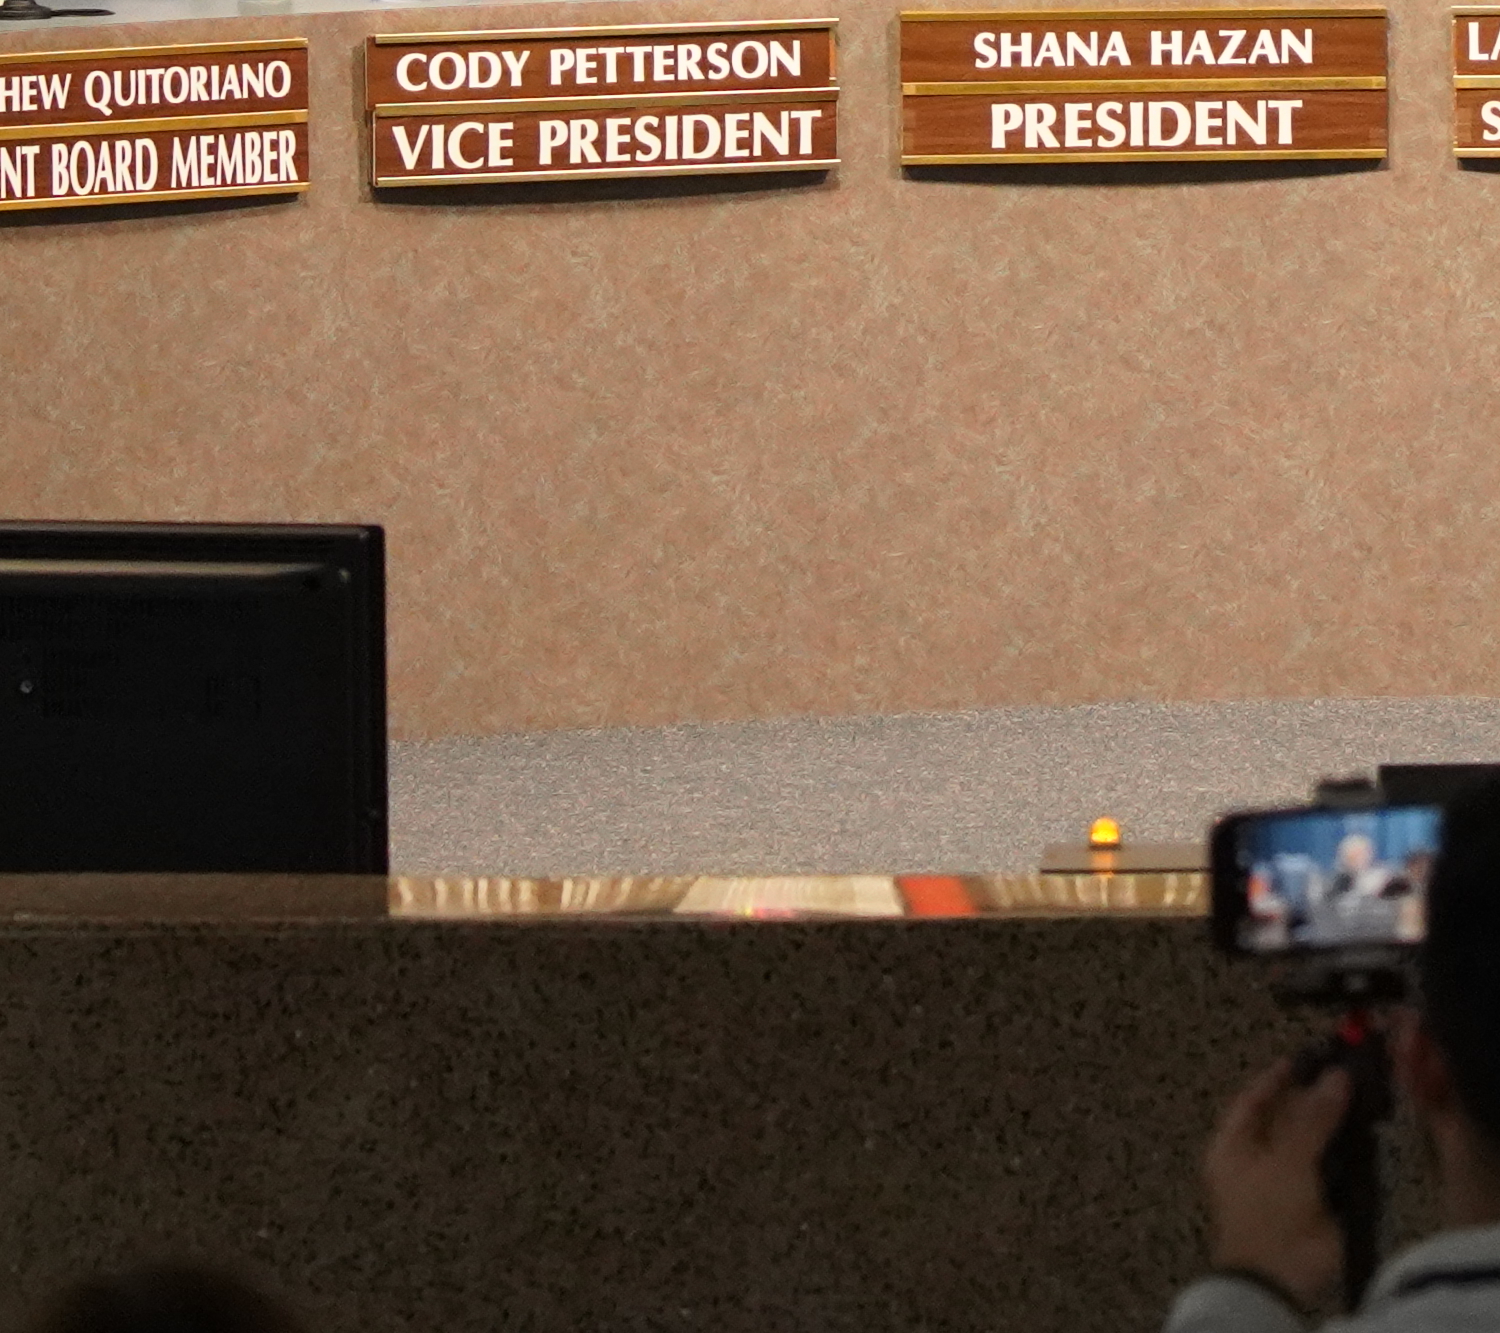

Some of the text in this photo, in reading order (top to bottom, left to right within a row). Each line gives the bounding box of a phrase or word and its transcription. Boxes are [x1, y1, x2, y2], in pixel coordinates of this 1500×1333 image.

[395, 39, 802, 93] CODY PETTERSON
[973, 29, 1314, 69] SHANA HAZAN
[84, 59, 292, 117] QUITORIANO
[391, 109, 823, 172] VICE PRESIDENT
[990, 99, 1303, 149] PRESIDENT
[51, 137, 158, 197] BOARD
[171, 129, 299, 190] MEMBER
